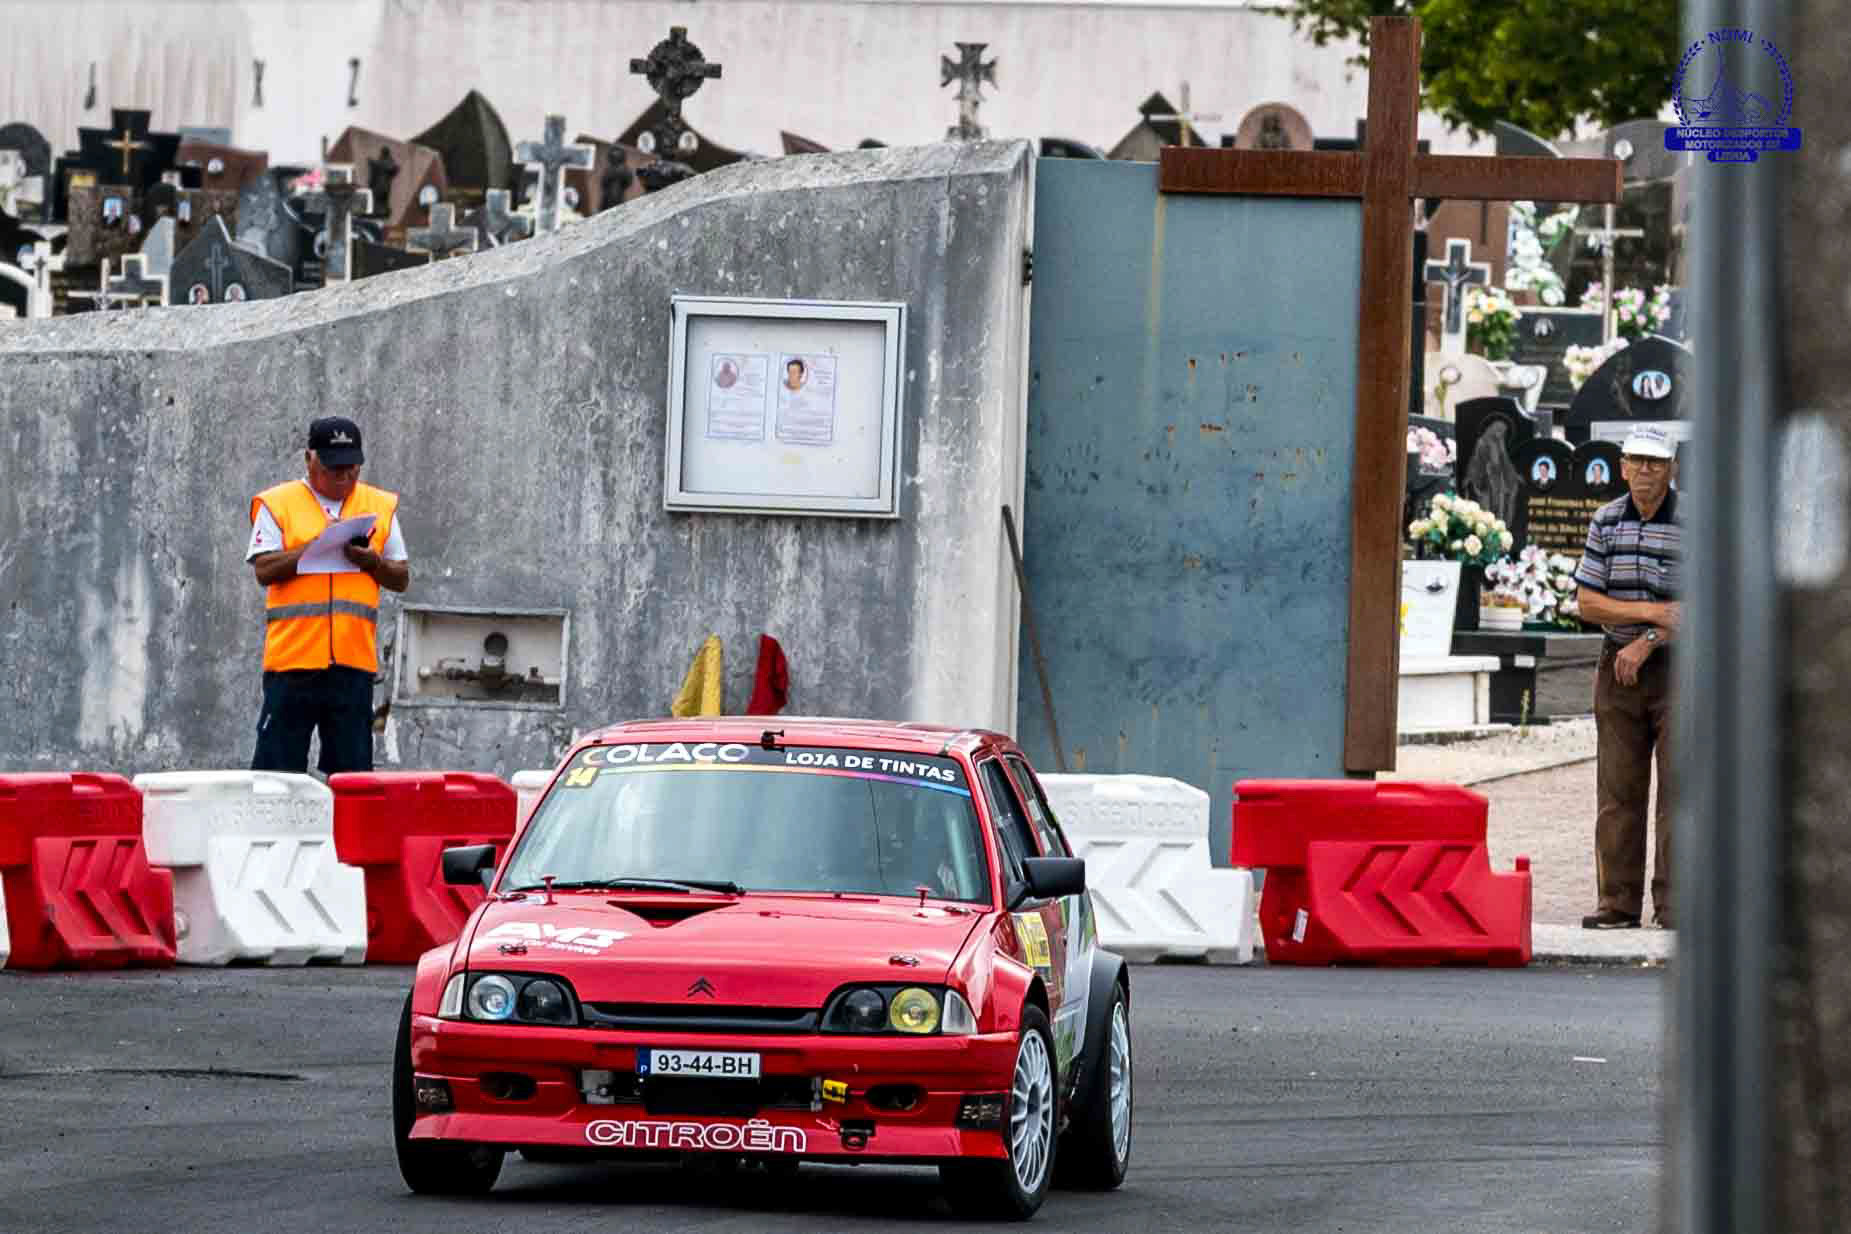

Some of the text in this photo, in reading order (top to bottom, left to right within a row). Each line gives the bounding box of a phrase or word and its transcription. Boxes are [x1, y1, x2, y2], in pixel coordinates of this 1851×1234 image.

[785, 752, 956, 782] LOJA DE TINTAS
[657, 1054, 752, 1075] 93-44-BH
